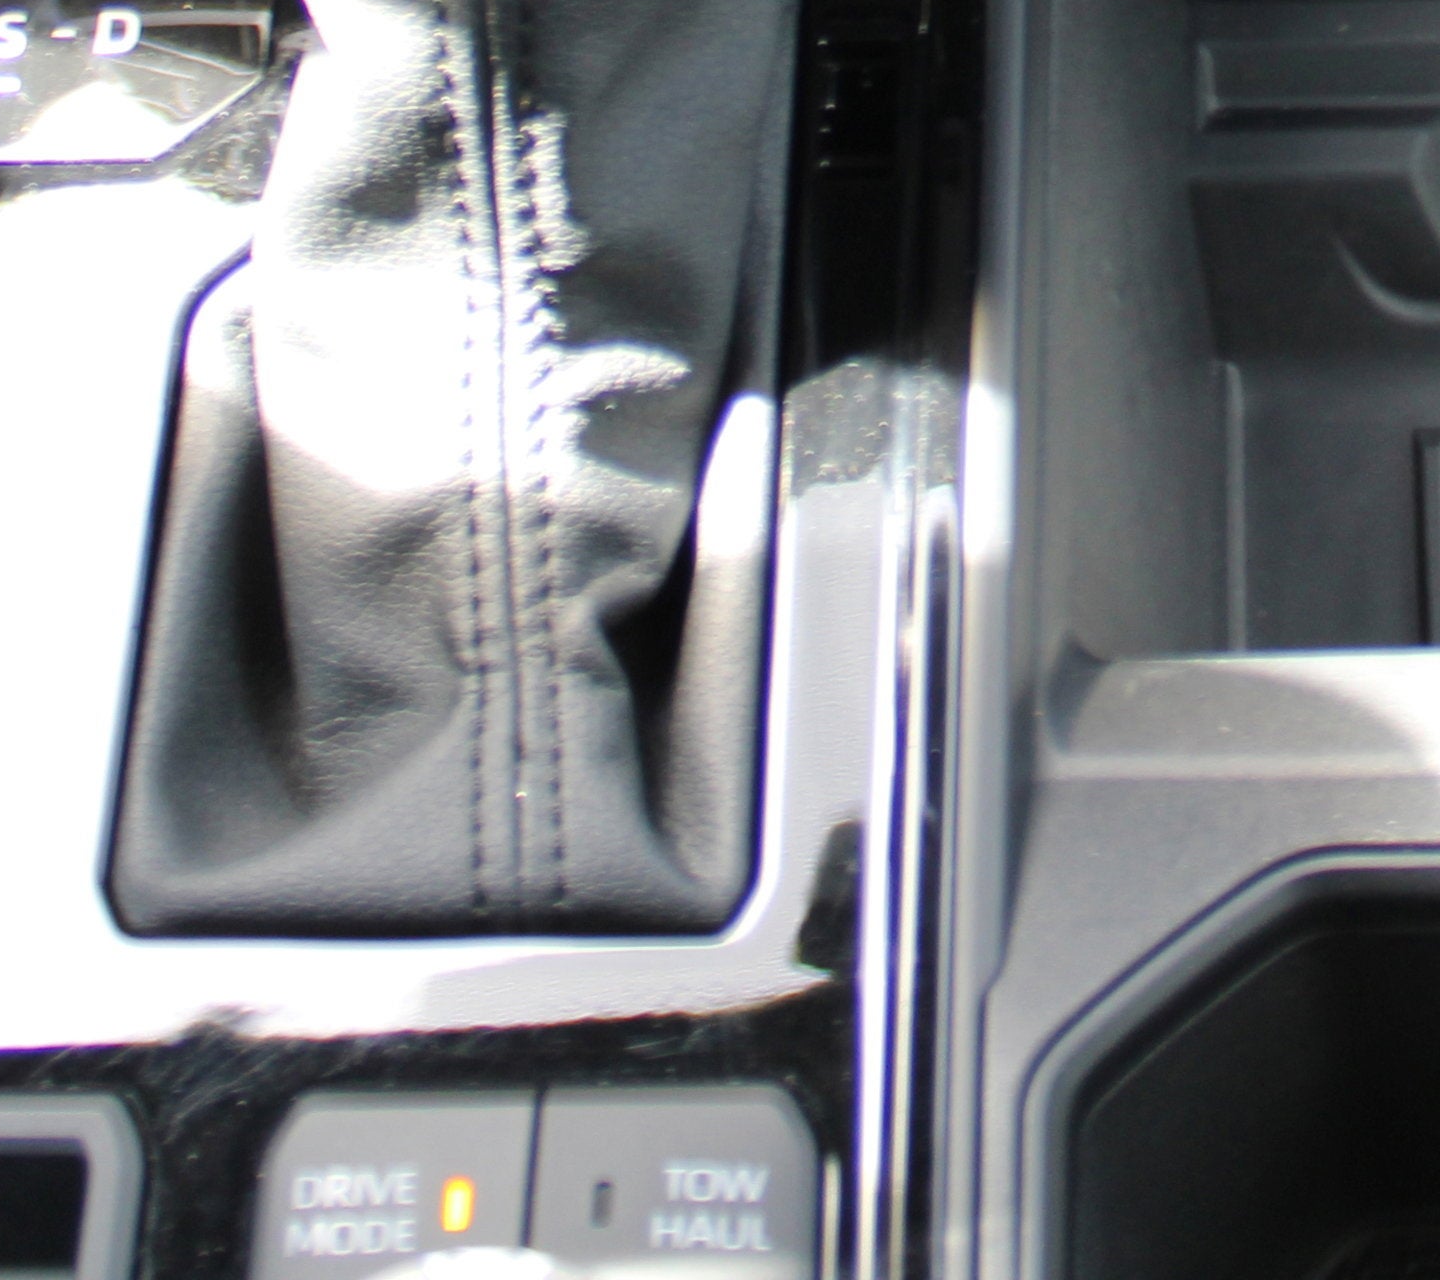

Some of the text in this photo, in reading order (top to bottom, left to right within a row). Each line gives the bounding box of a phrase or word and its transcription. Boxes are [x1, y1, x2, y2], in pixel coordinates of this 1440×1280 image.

[291, 1168, 417, 1212] DRIVE
[665, 1162, 767, 1204] TOW
[286, 1214, 416, 1258] MODE
[650, 1208, 772, 1253] HAUL
